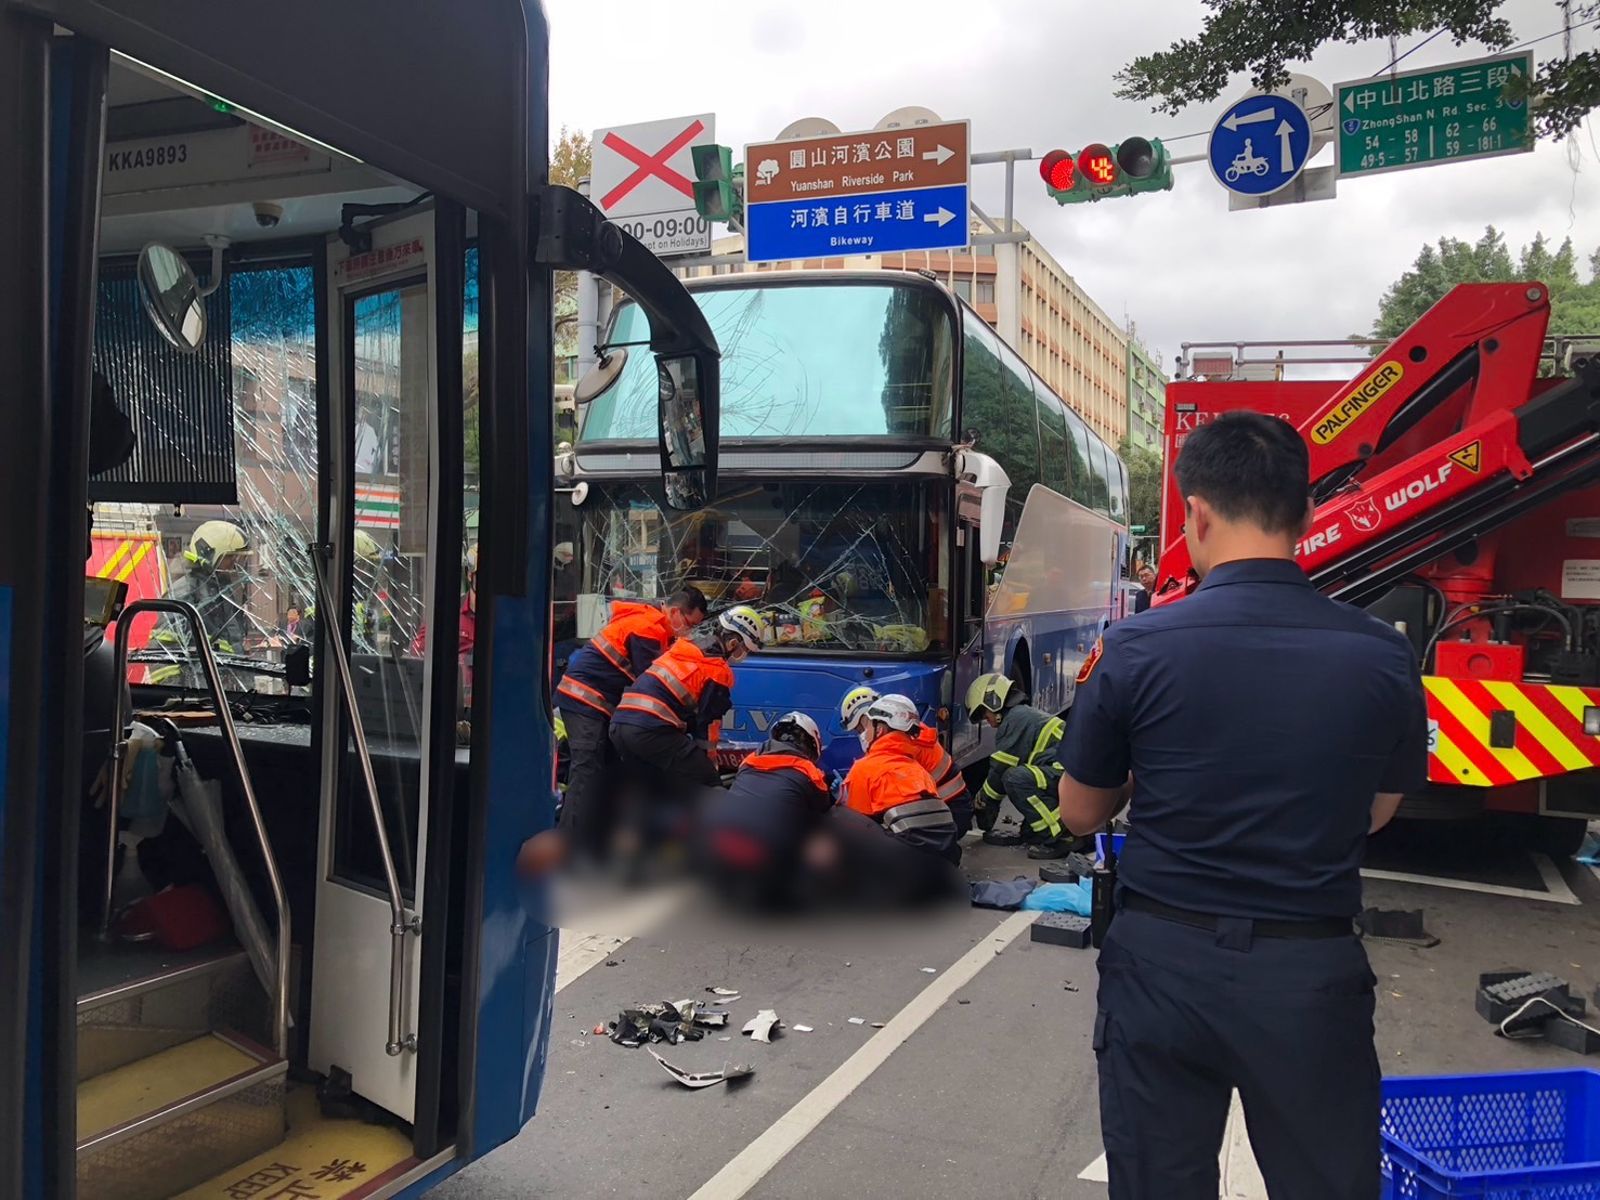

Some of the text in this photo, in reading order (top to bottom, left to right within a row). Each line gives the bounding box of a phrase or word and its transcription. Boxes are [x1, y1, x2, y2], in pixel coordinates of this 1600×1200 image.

[1357, 66, 1509, 109] 中山北路三段
[1363, 113, 1422, 130] ZhongShan
[1446, 123, 1459, 138] 62
[1483, 117, 1497, 132] 66
[1366, 135, 1379, 150] 54
[1405, 129, 1418, 144] 58
[1446, 142, 1459, 157] 59
[108, 144, 187, 172] KKA9893
[790, 137, 914, 169] 圓山河濱公園
[1405, 147, 1418, 162] 57
[791, 170, 914, 192] Yuanshan Riverside Park
[791, 199, 915, 229] 河濱自行車道
[658, 241, 668, 249] on
[830, 236, 873, 247] Bikeway
[1315, 366, 1398, 440] PALFINGER
[1384, 461, 1453, 511] WOLF
[223, 1162, 304, 1200] KEEP
